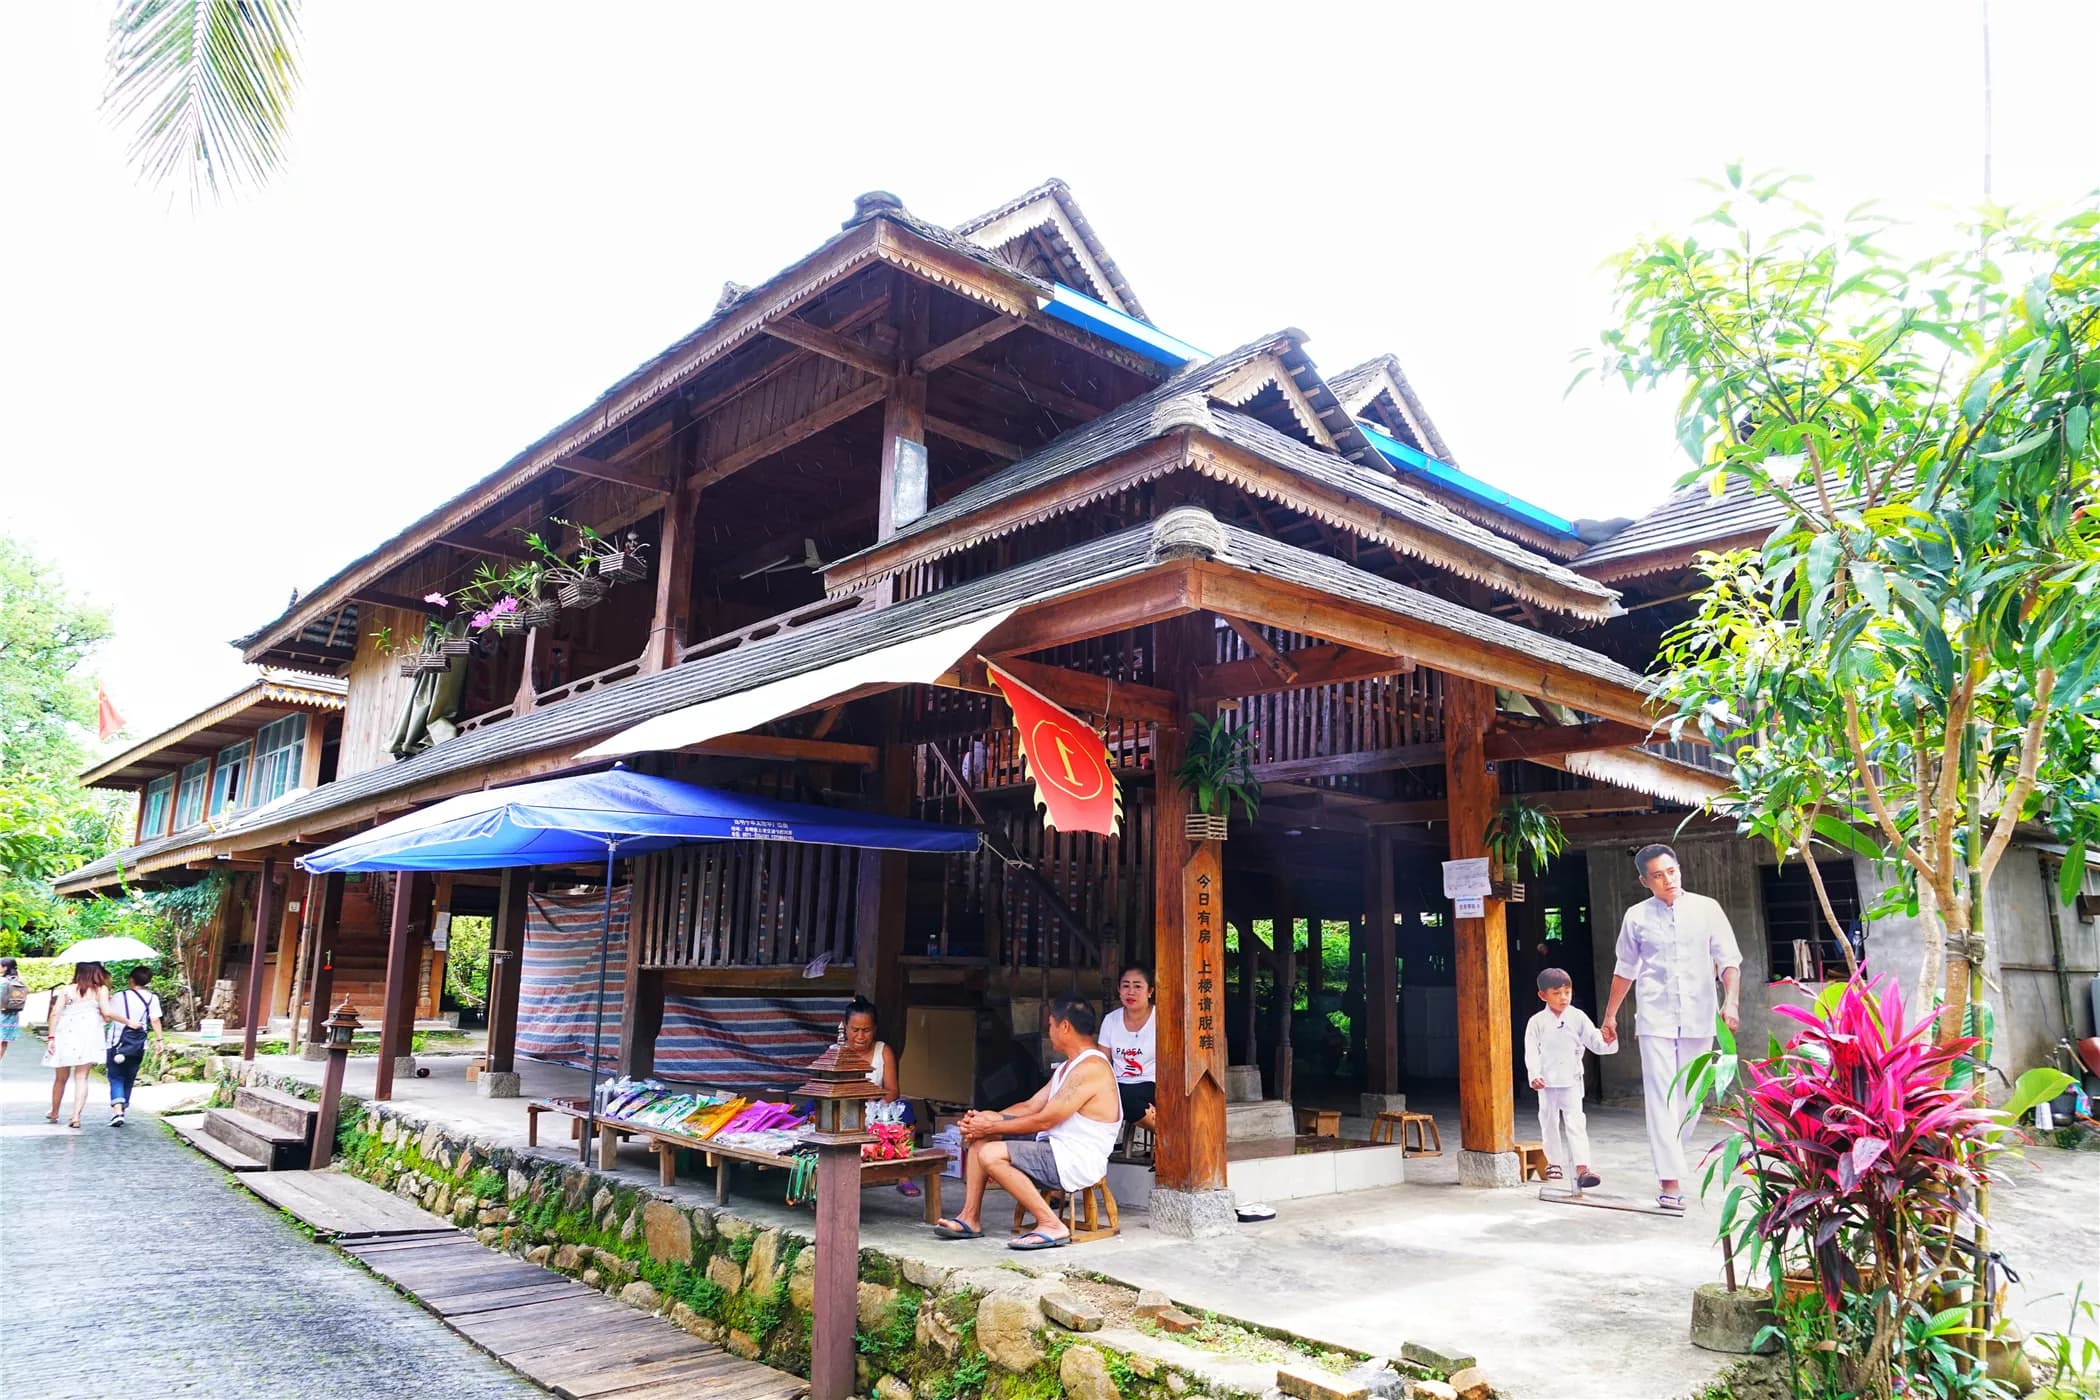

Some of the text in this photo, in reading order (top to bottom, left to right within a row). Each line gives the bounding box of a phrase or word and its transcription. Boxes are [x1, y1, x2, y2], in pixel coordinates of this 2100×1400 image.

[1197, 874, 1214, 1049] 今日有房 上楼请脱鞋
